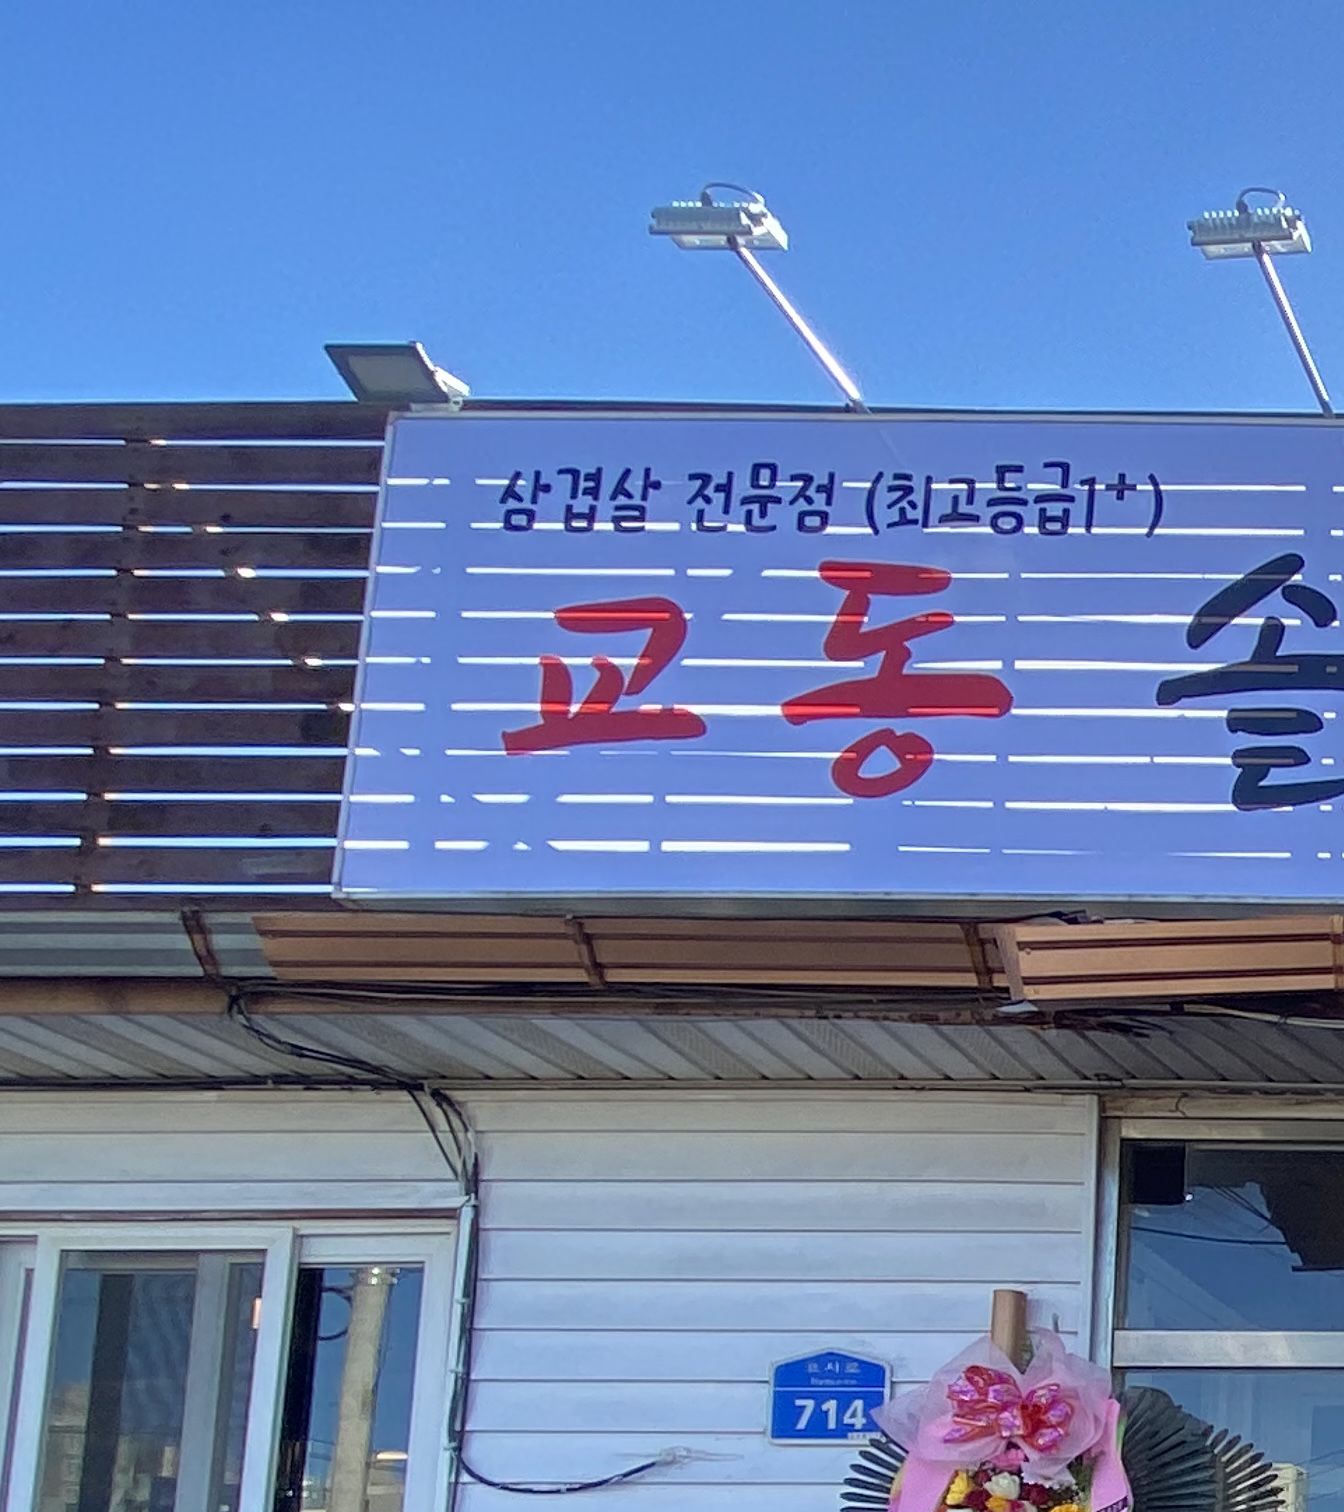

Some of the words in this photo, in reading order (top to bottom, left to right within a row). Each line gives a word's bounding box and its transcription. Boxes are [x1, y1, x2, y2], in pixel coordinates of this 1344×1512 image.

[499, 466, 661, 534] 삼겹살
[686, 462, 835, 533] 전문점
[501, 560, 1014, 799] 교동
[794, 1398, 867, 1431] 714
